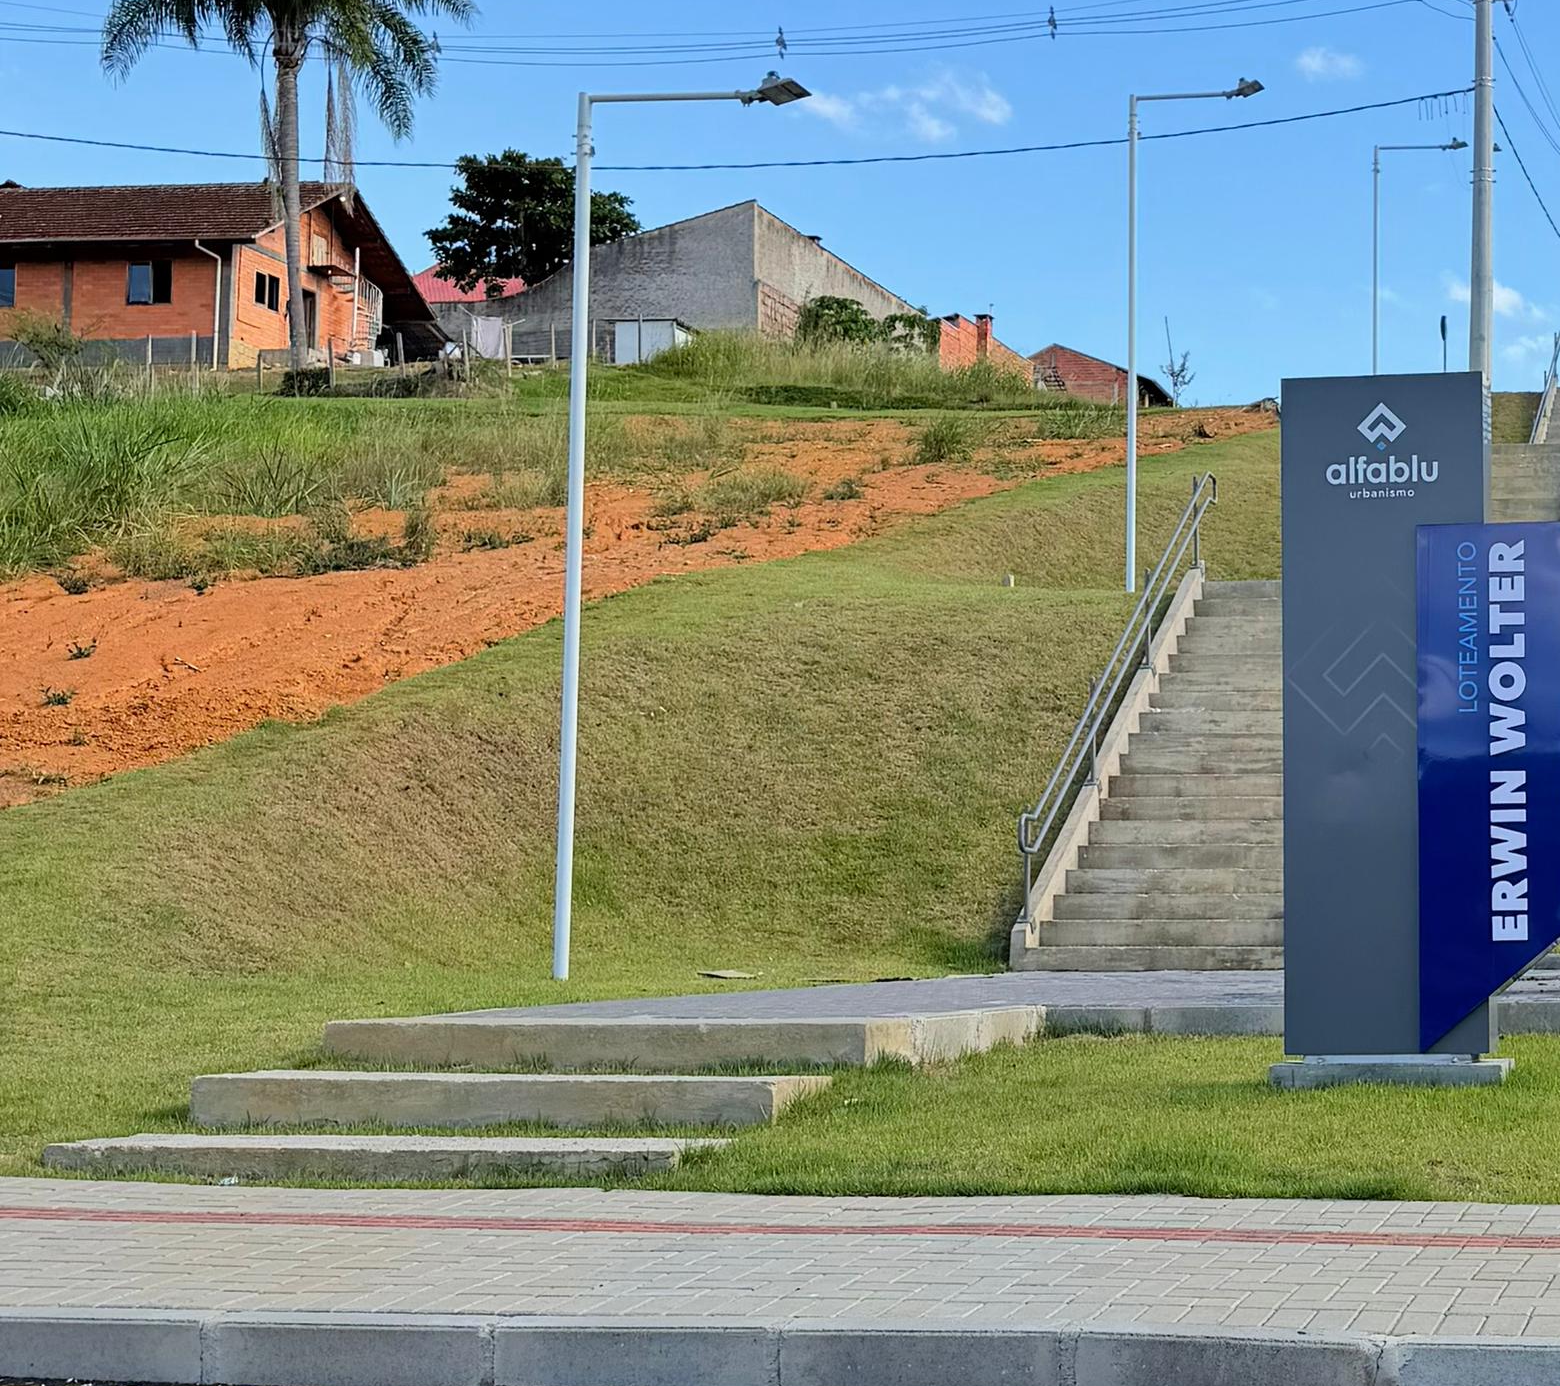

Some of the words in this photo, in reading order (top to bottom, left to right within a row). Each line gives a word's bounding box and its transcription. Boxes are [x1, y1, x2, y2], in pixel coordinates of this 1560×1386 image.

[1326, 454, 1439, 485] alfablu
[1349, 488, 1415, 499] urbanismo
[1457, 541, 1478, 713] LOTEAMENTO
[1488, 539, 1527, 756] WOLTER
[1490, 770, 1529, 941] ERWIN
